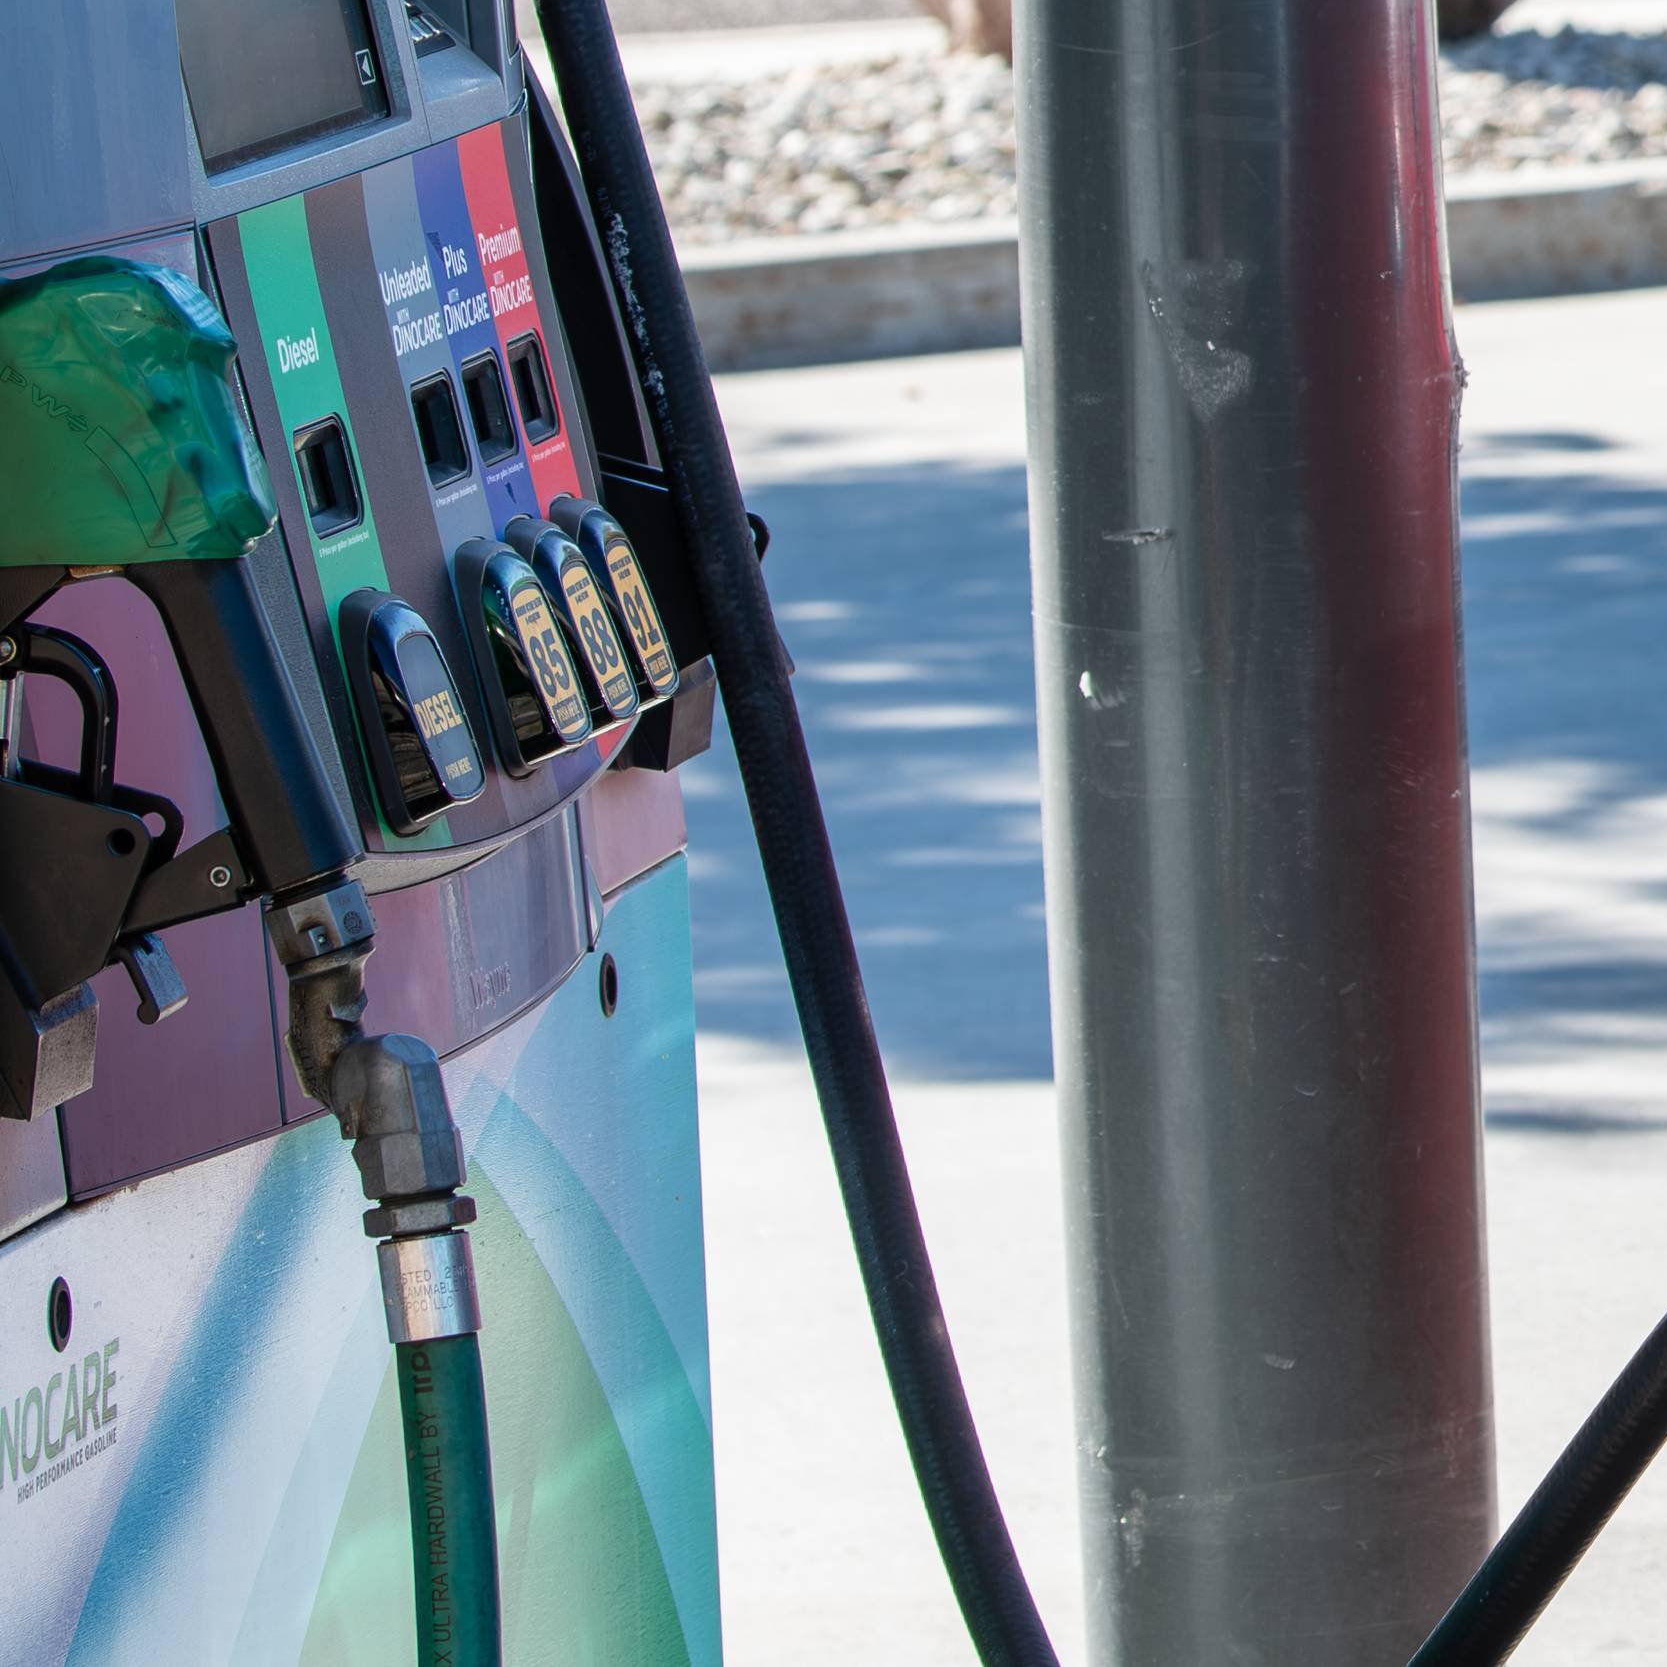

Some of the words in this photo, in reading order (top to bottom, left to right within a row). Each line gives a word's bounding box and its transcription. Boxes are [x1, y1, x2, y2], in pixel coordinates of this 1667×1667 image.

[442, 244, 468, 279] Plus
[478, 224, 522, 266] Premium
[379, 256, 432, 306] Unleaded
[490, 275, 533, 318] DINOCARE
[392, 311, 443, 357] DINOCARE
[443, 292, 490, 335] DINOCARE
[276, 327, 319, 373] Diesel
[579, 608, 619, 676] 88
[623, 585, 656, 651] 91
[529, 628, 570, 699] 85
[413, 690, 462, 739] DIESEL
[416, 1411, 438, 1440] BY
[17, 1480, 35, 1505] HIGH
[35, 1449, 84, 1494] PERFORMANCE
[84, 1427, 118, 1461] GASOLINE
[423, 1445, 447, 1565] HARDWALL
[431, 1573, 451, 1643] ULTRA
